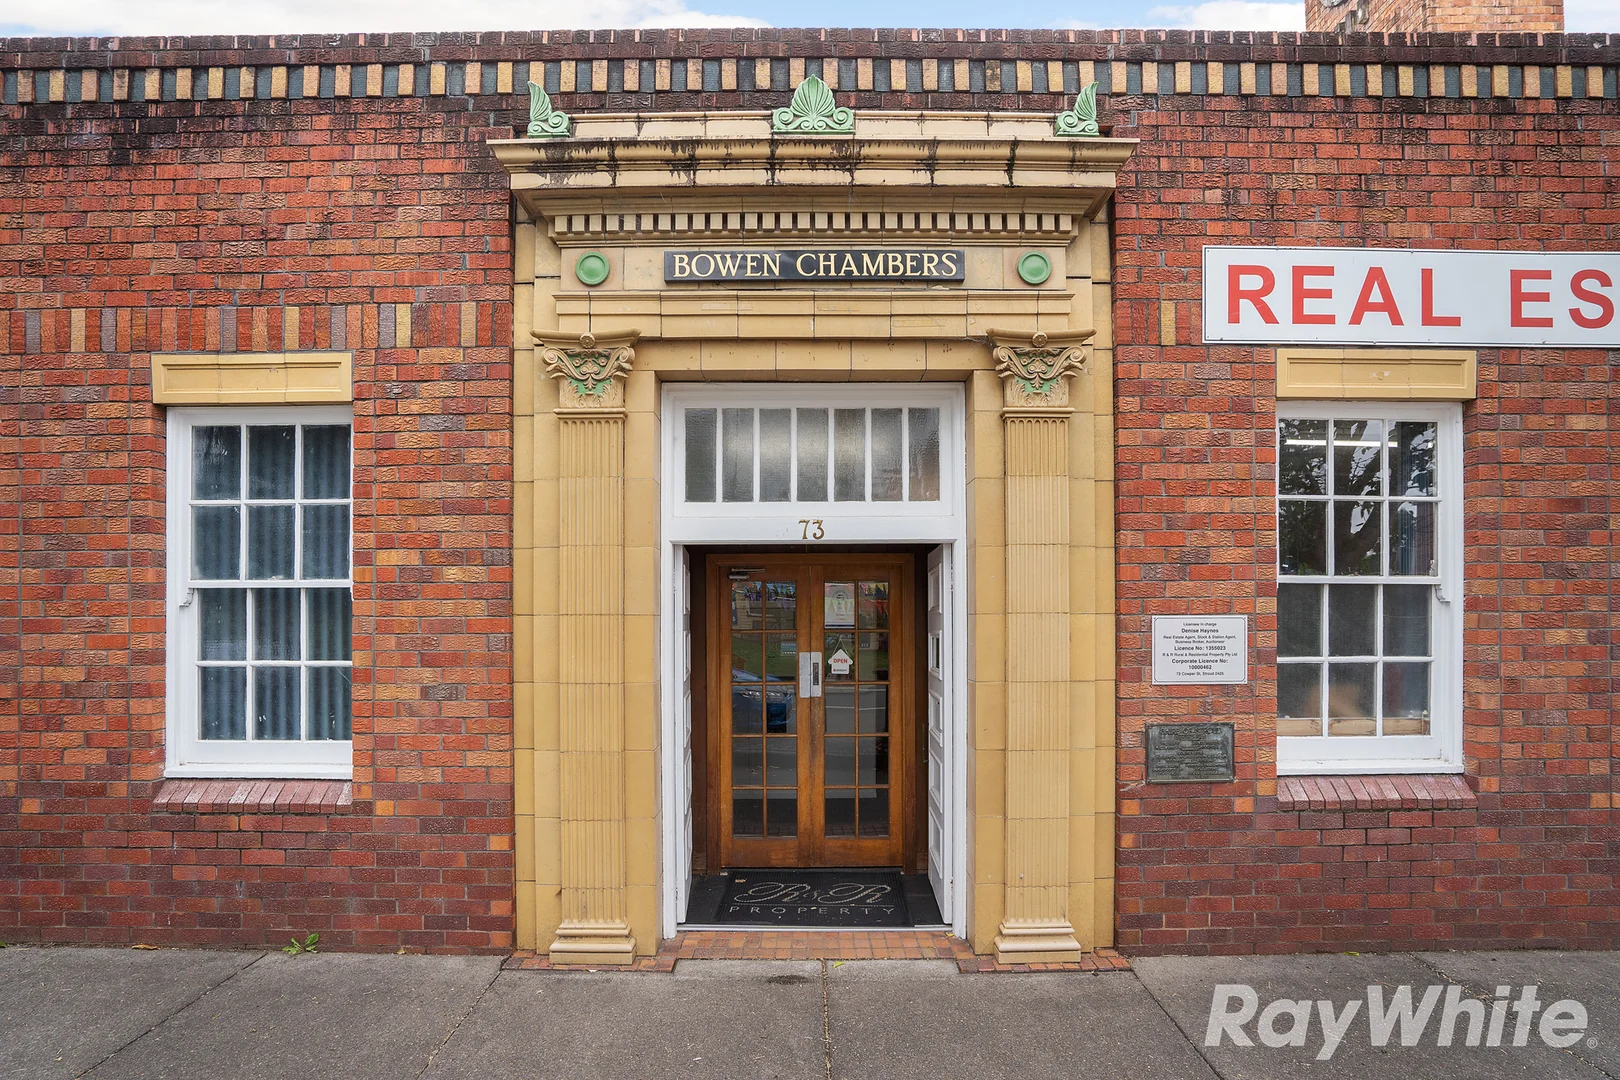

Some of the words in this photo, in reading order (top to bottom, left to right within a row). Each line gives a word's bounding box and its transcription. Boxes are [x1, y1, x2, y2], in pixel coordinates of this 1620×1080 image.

[673, 253, 781, 278] BOWEN
[796, 253, 958, 277] CHAMBERS
[1227, 264, 1462, 327] REAL
[798, 519, 825, 540] 73
[729, 906, 894, 915] PROPERTY
